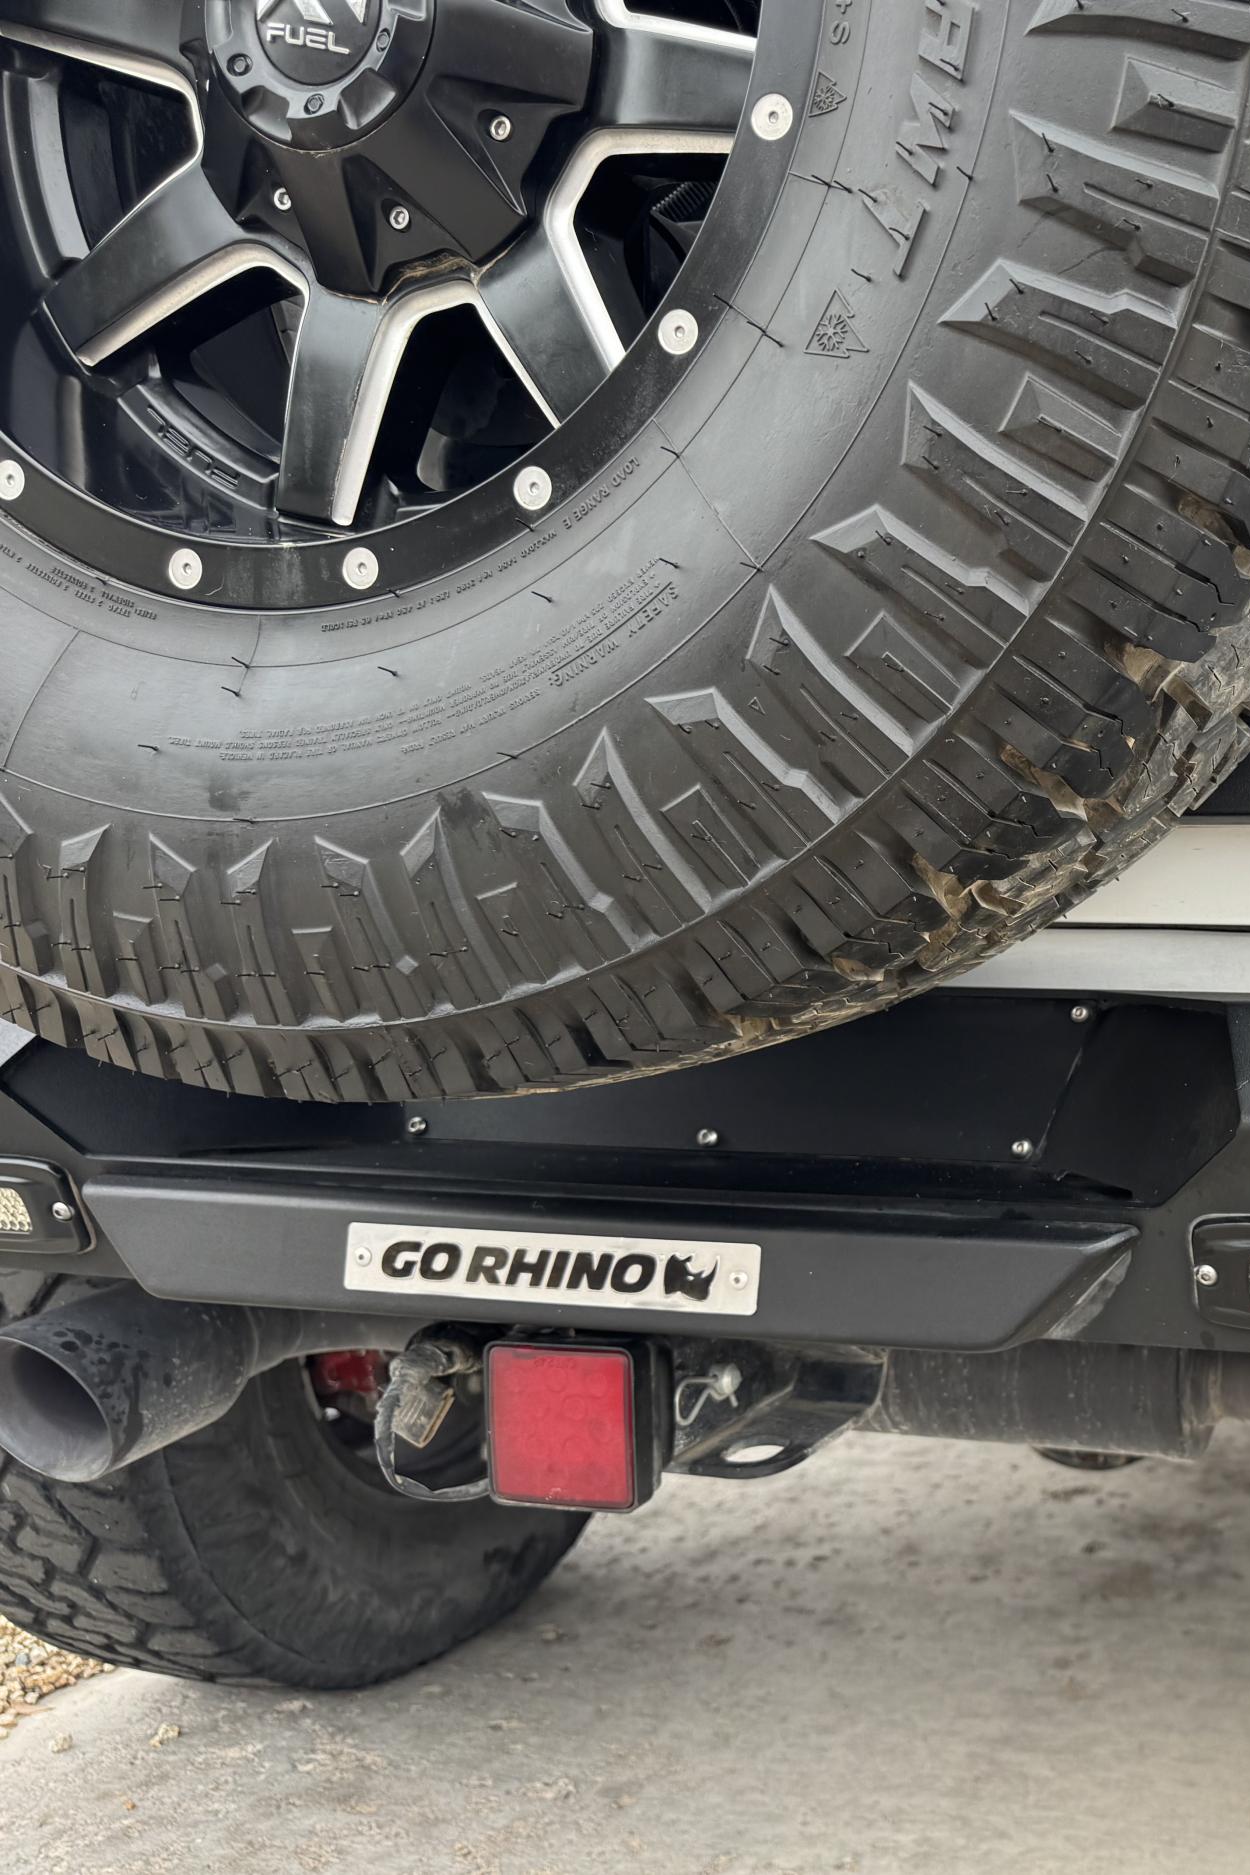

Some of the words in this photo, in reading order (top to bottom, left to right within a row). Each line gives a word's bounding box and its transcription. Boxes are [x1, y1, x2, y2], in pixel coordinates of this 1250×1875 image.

[266, 22, 350, 55] FUEL
[146, 407, 240, 491] FUEL
[608, 455, 641, 489] LOAD
[559, 515, 574, 531] E
[569, 483, 611, 523] RANGE
[622, 585, 680, 638] SAFETY
[546, 636, 619, 690] WARNING:
[381, 1240, 462, 1281] GO
[466, 1246, 657, 1293] RHINO
